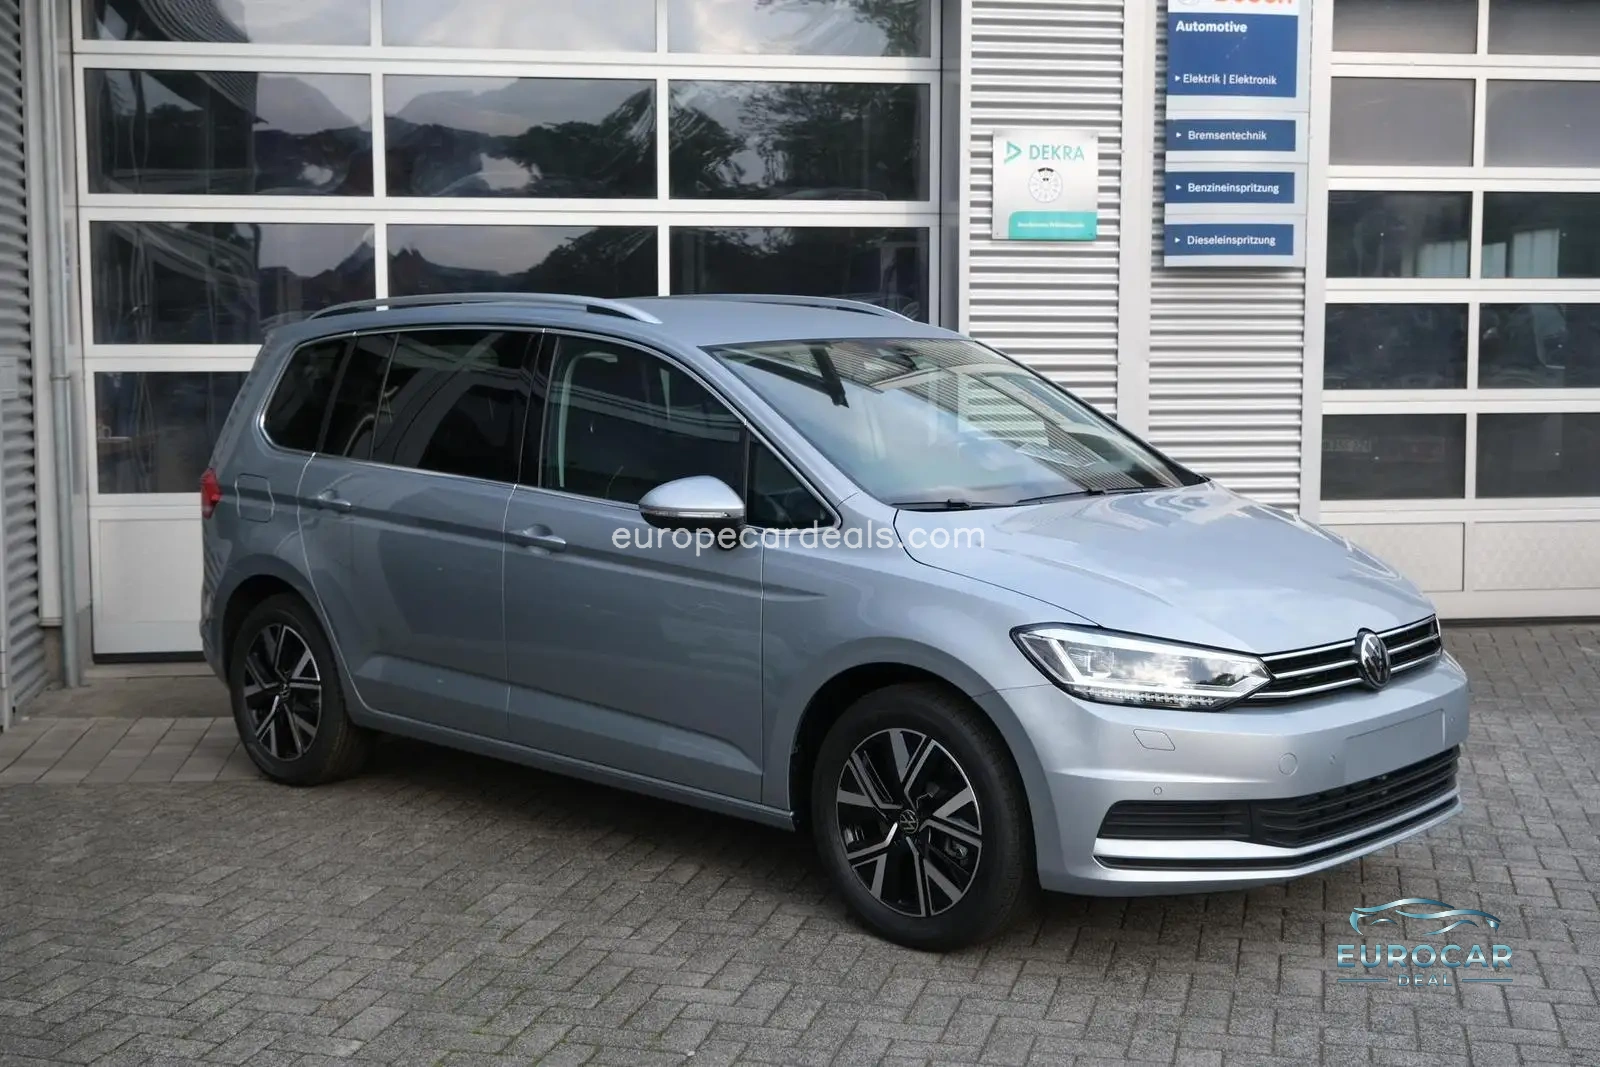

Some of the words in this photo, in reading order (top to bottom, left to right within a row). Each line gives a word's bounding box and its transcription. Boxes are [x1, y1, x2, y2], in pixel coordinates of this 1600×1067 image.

[1175, 20, 1248, 33] Automotive
[1182, 73, 1221, 84] Elektrik
[1229, 74, 1278, 85] Elektronik
[1187, 130, 1268, 141] Bremsentechnik
[1029, 144, 1085, 161] DEKRA
[1187, 182, 1280, 195] Benzineinspritzung
[1187, 235, 1276, 247] Dieseleinspritzung
